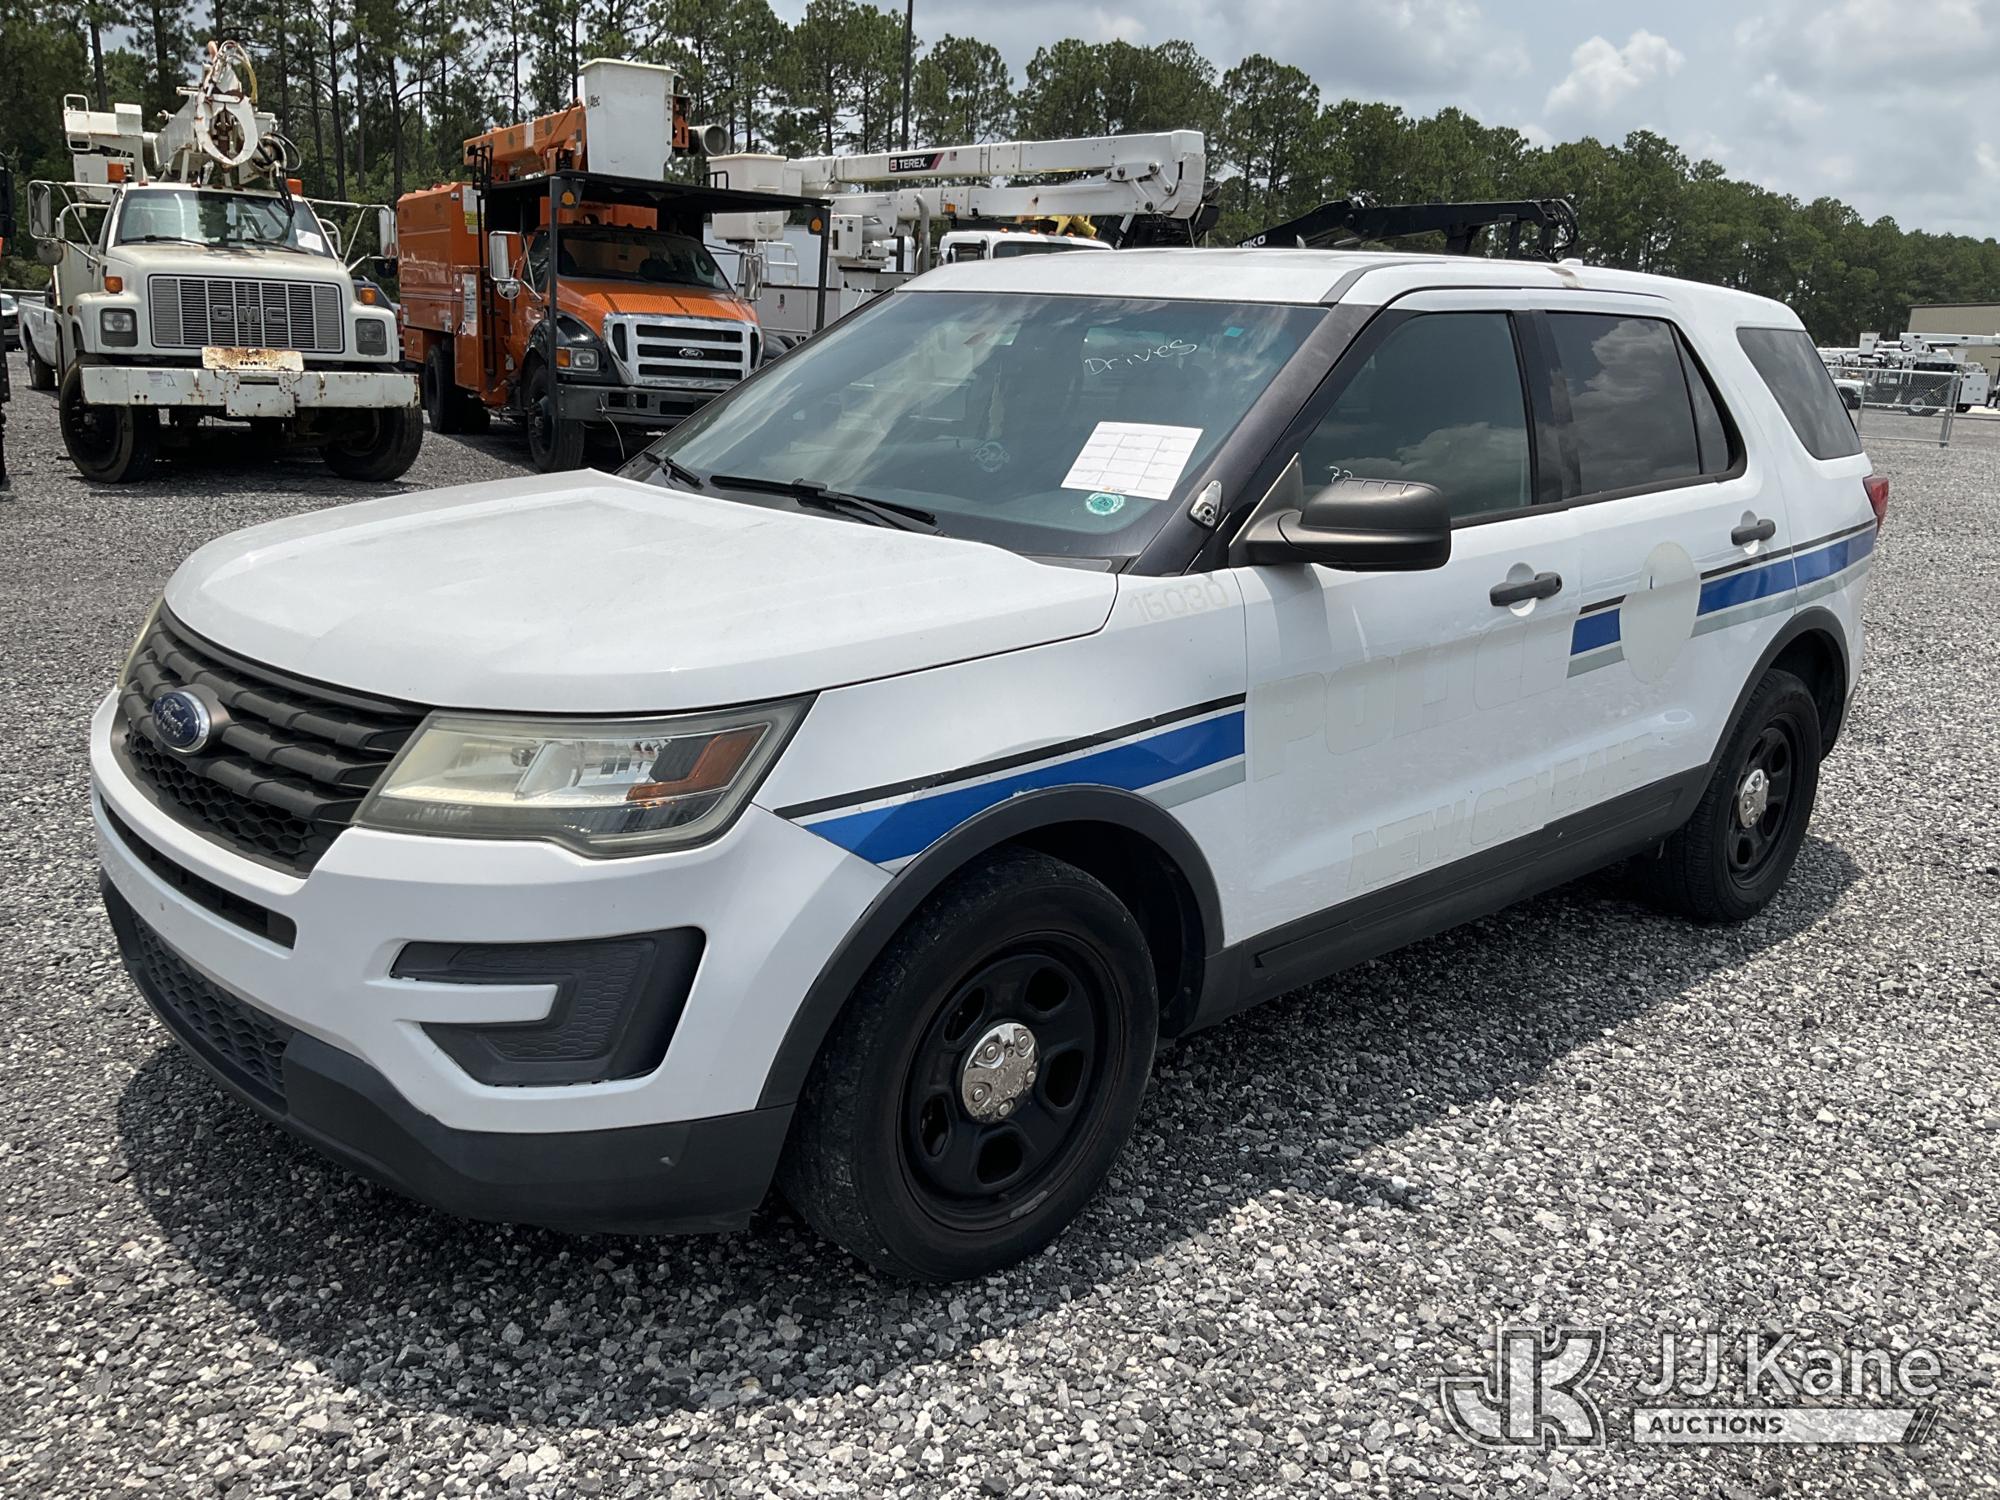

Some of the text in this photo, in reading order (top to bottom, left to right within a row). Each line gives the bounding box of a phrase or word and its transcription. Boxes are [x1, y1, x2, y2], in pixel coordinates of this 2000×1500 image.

[898, 157, 926, 169] TEREX
[211, 304, 286, 324] GMC
[681, 348, 702, 358] Ford
[1084, 339, 1197, 375] Drives
[1128, 581, 1229, 621] 16030
[158, 697, 190, 739] Ford
